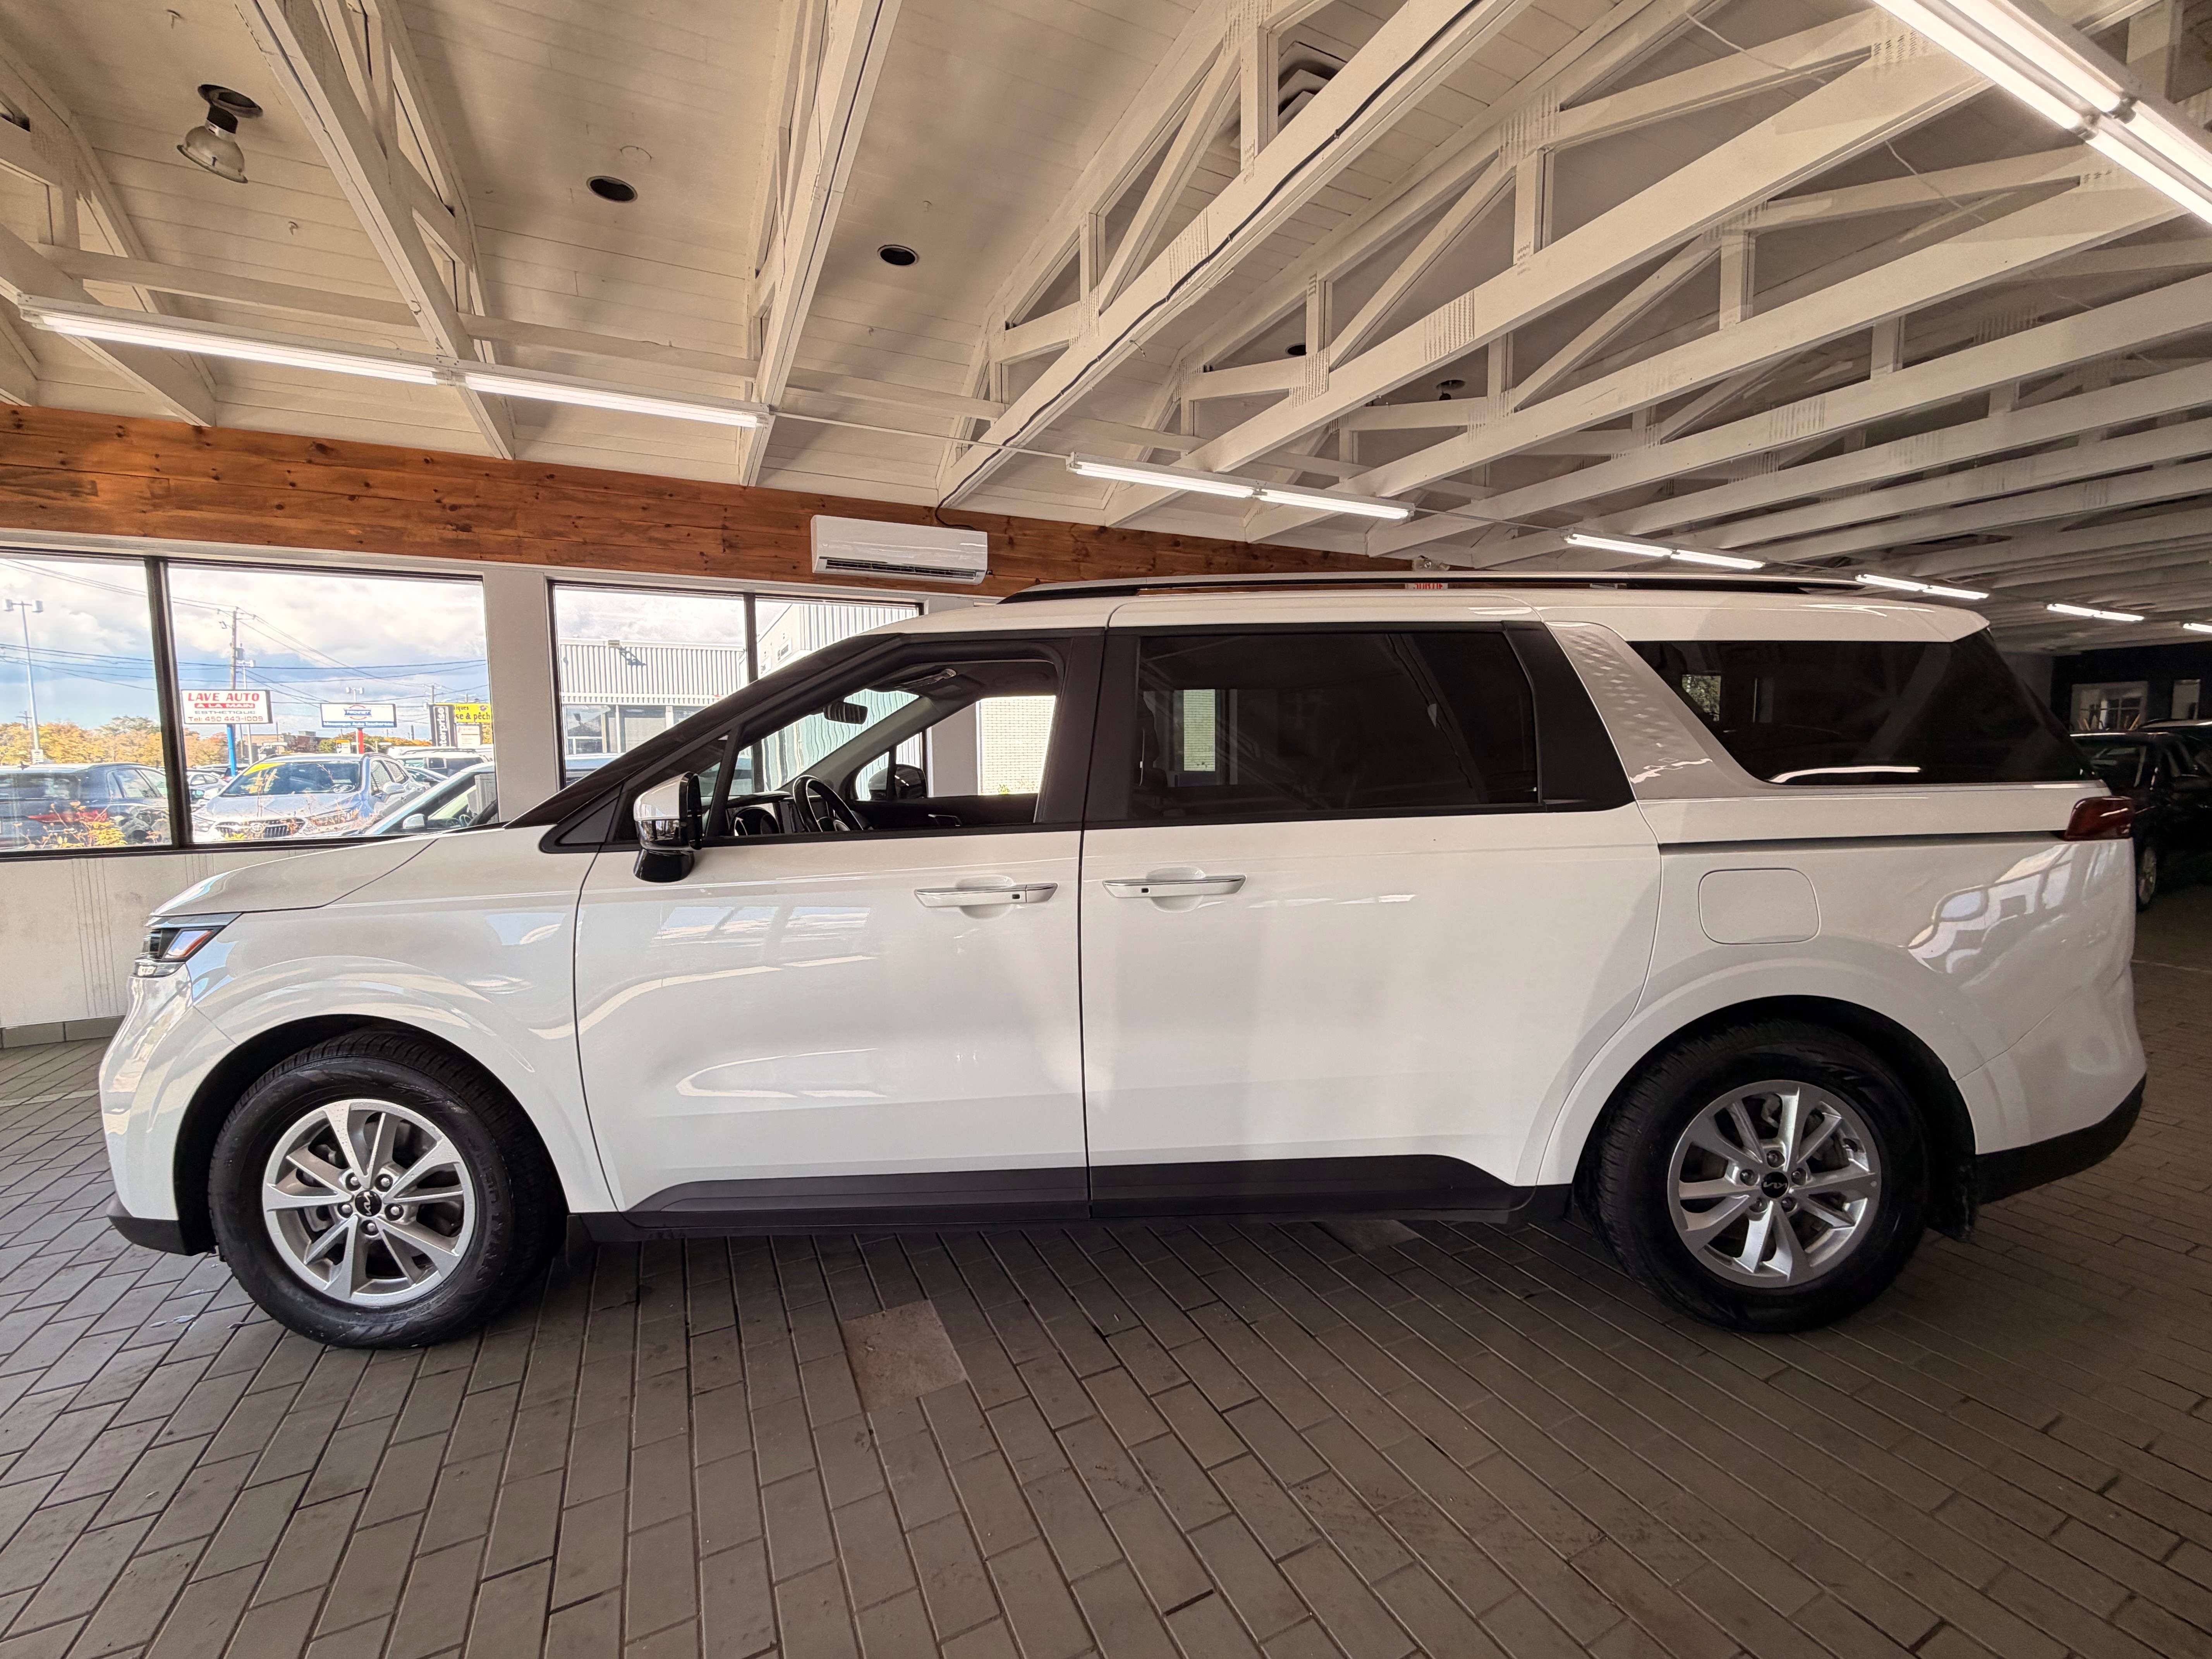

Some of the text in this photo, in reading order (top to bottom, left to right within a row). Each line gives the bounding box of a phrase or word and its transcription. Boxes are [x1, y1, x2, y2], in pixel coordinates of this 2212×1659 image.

[188, 693, 260, 701] LAVE AUTO
[473, 712, 491, 722] pêch
